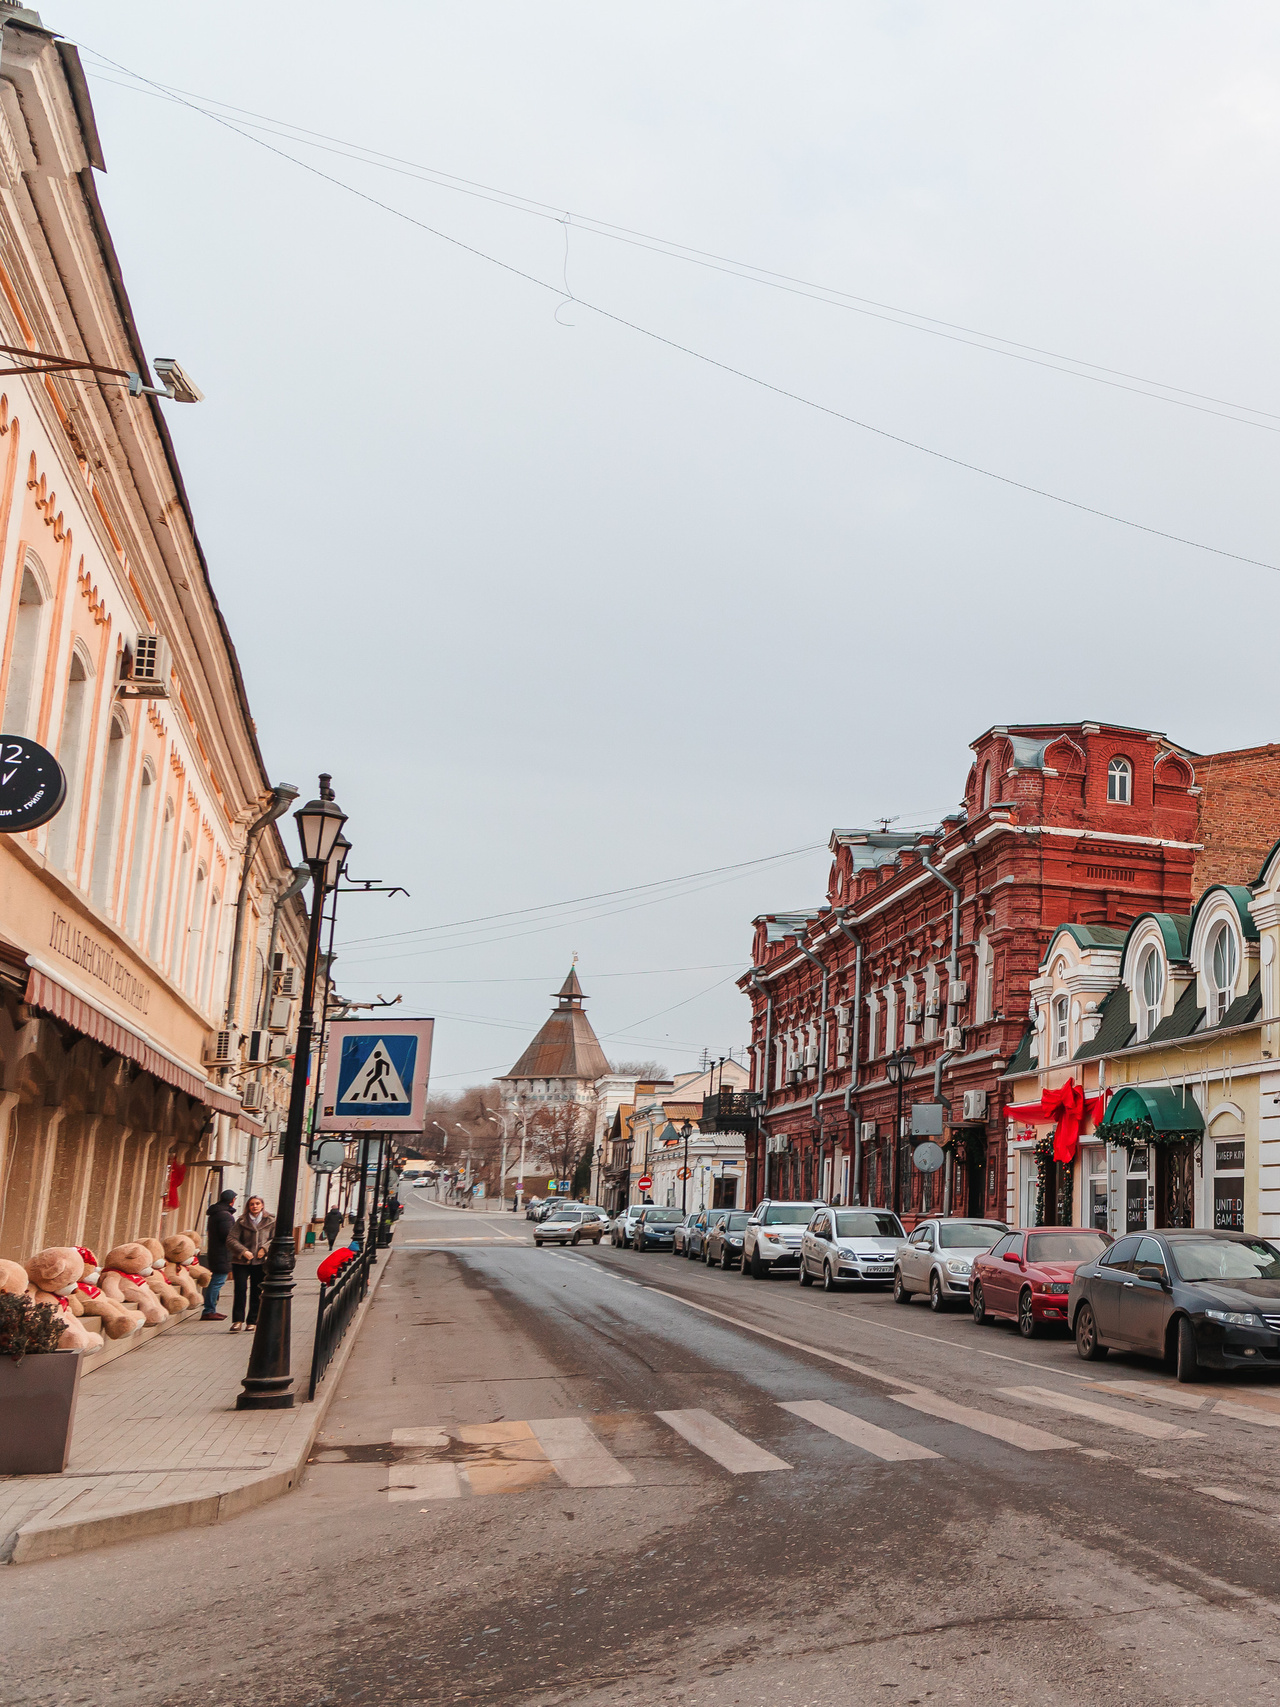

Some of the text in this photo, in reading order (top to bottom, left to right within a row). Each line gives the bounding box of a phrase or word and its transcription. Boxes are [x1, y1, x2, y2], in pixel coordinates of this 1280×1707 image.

[24, 790, 45, 810] ГРИЛЬ
[49, 911, 114, 987] ИТАЛЬЯНСКИЙ
[112, 960, 145, 1011] РЕСТОРАН
[1215, 1198, 1242, 1211] UNITED
